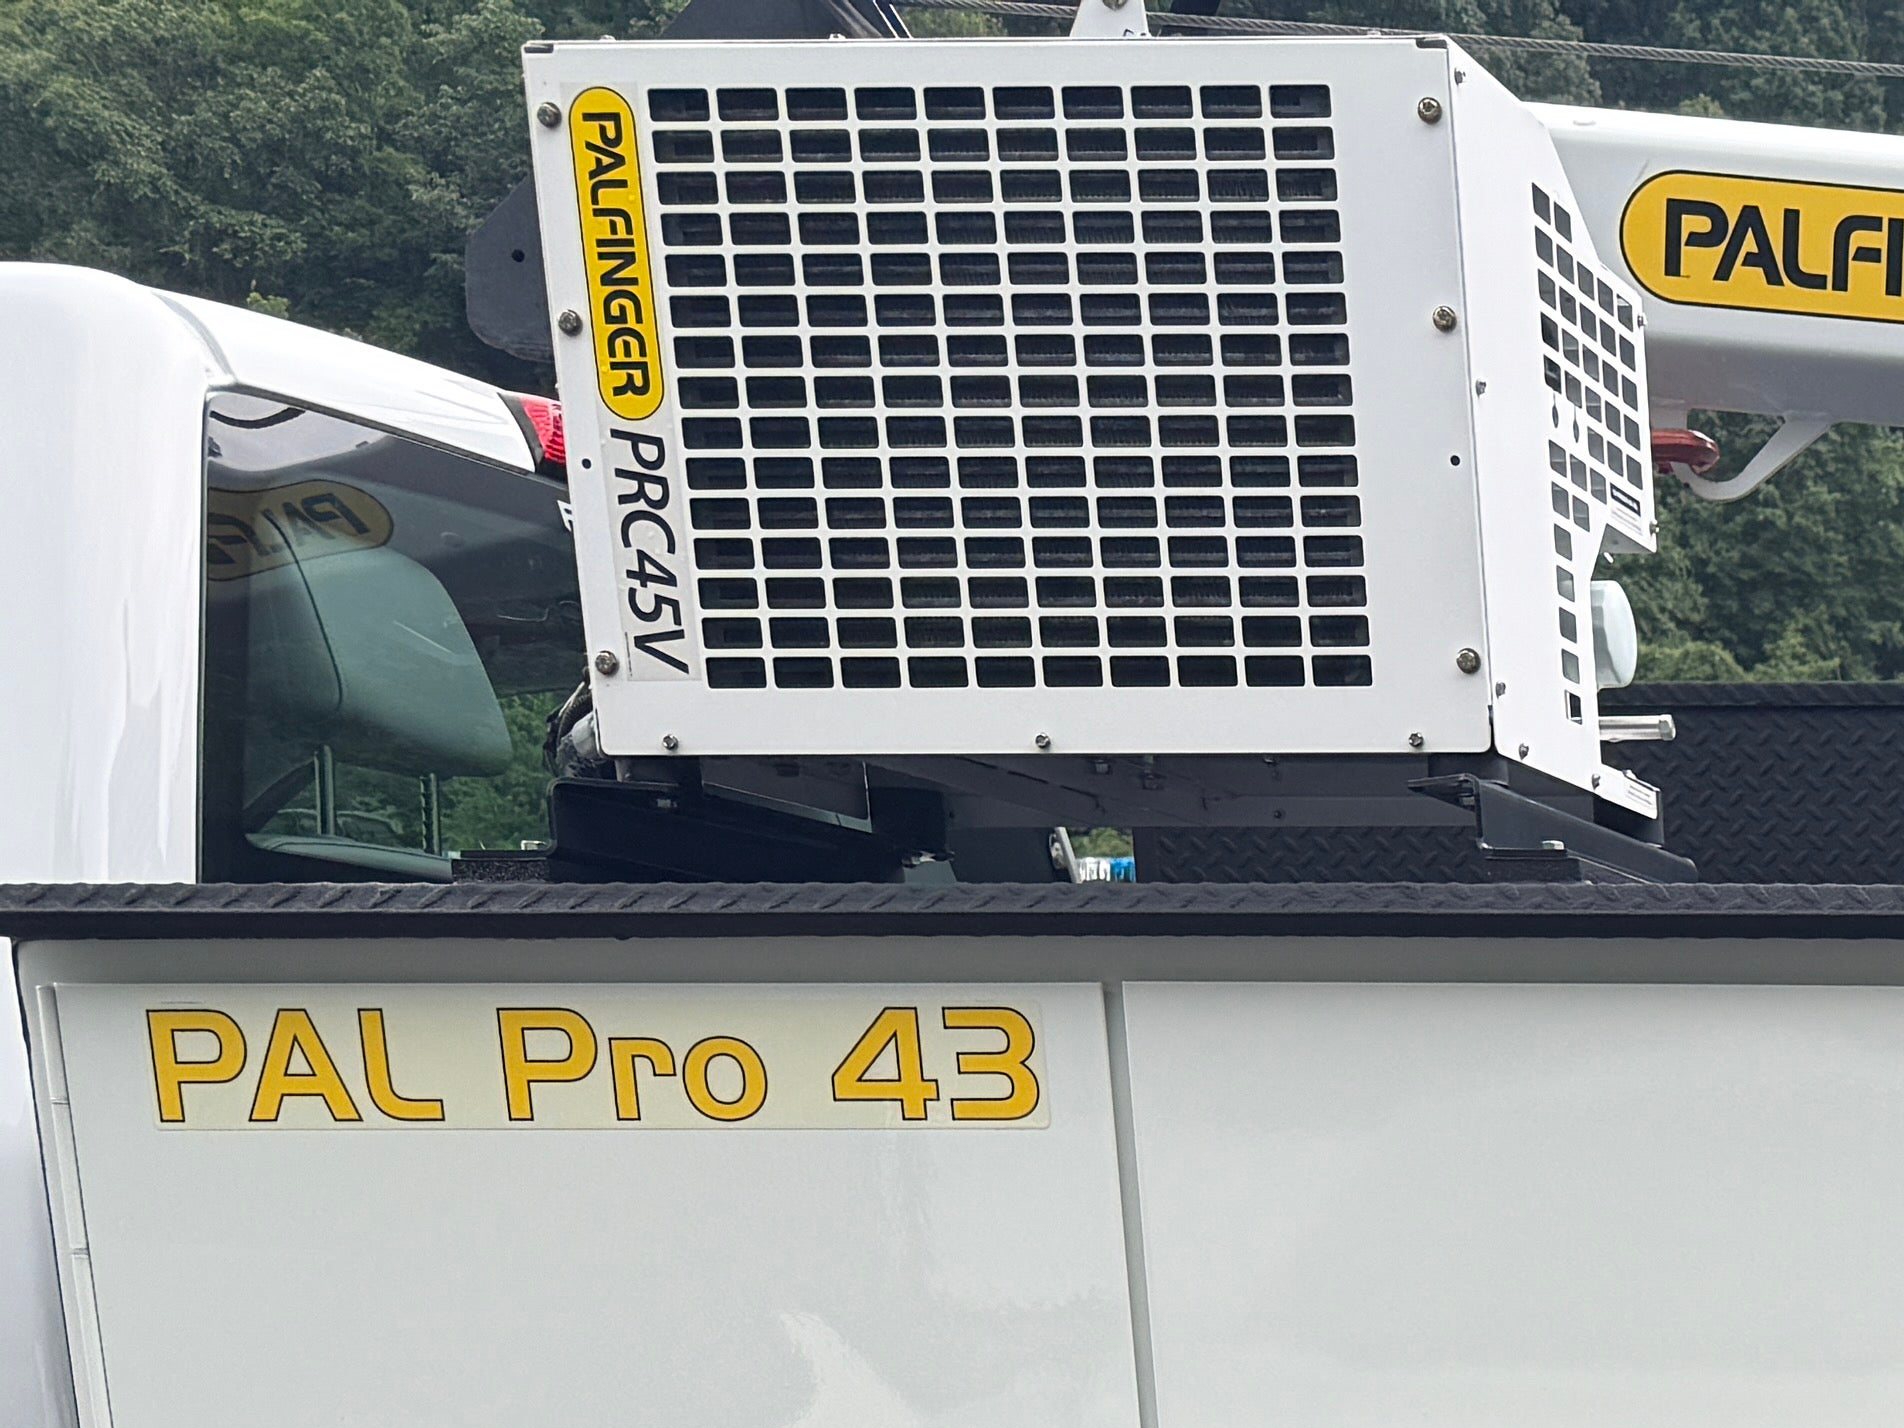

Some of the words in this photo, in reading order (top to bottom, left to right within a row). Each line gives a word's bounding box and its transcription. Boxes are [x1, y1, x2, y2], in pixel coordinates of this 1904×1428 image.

[580, 111, 651, 398] PALFINGER
[610, 428, 690, 675] PRC45V
[145, 1007, 444, 1123] PAL
[496, 1007, 769, 1123] Pro
[830, 1006, 1041, 1121] 43
